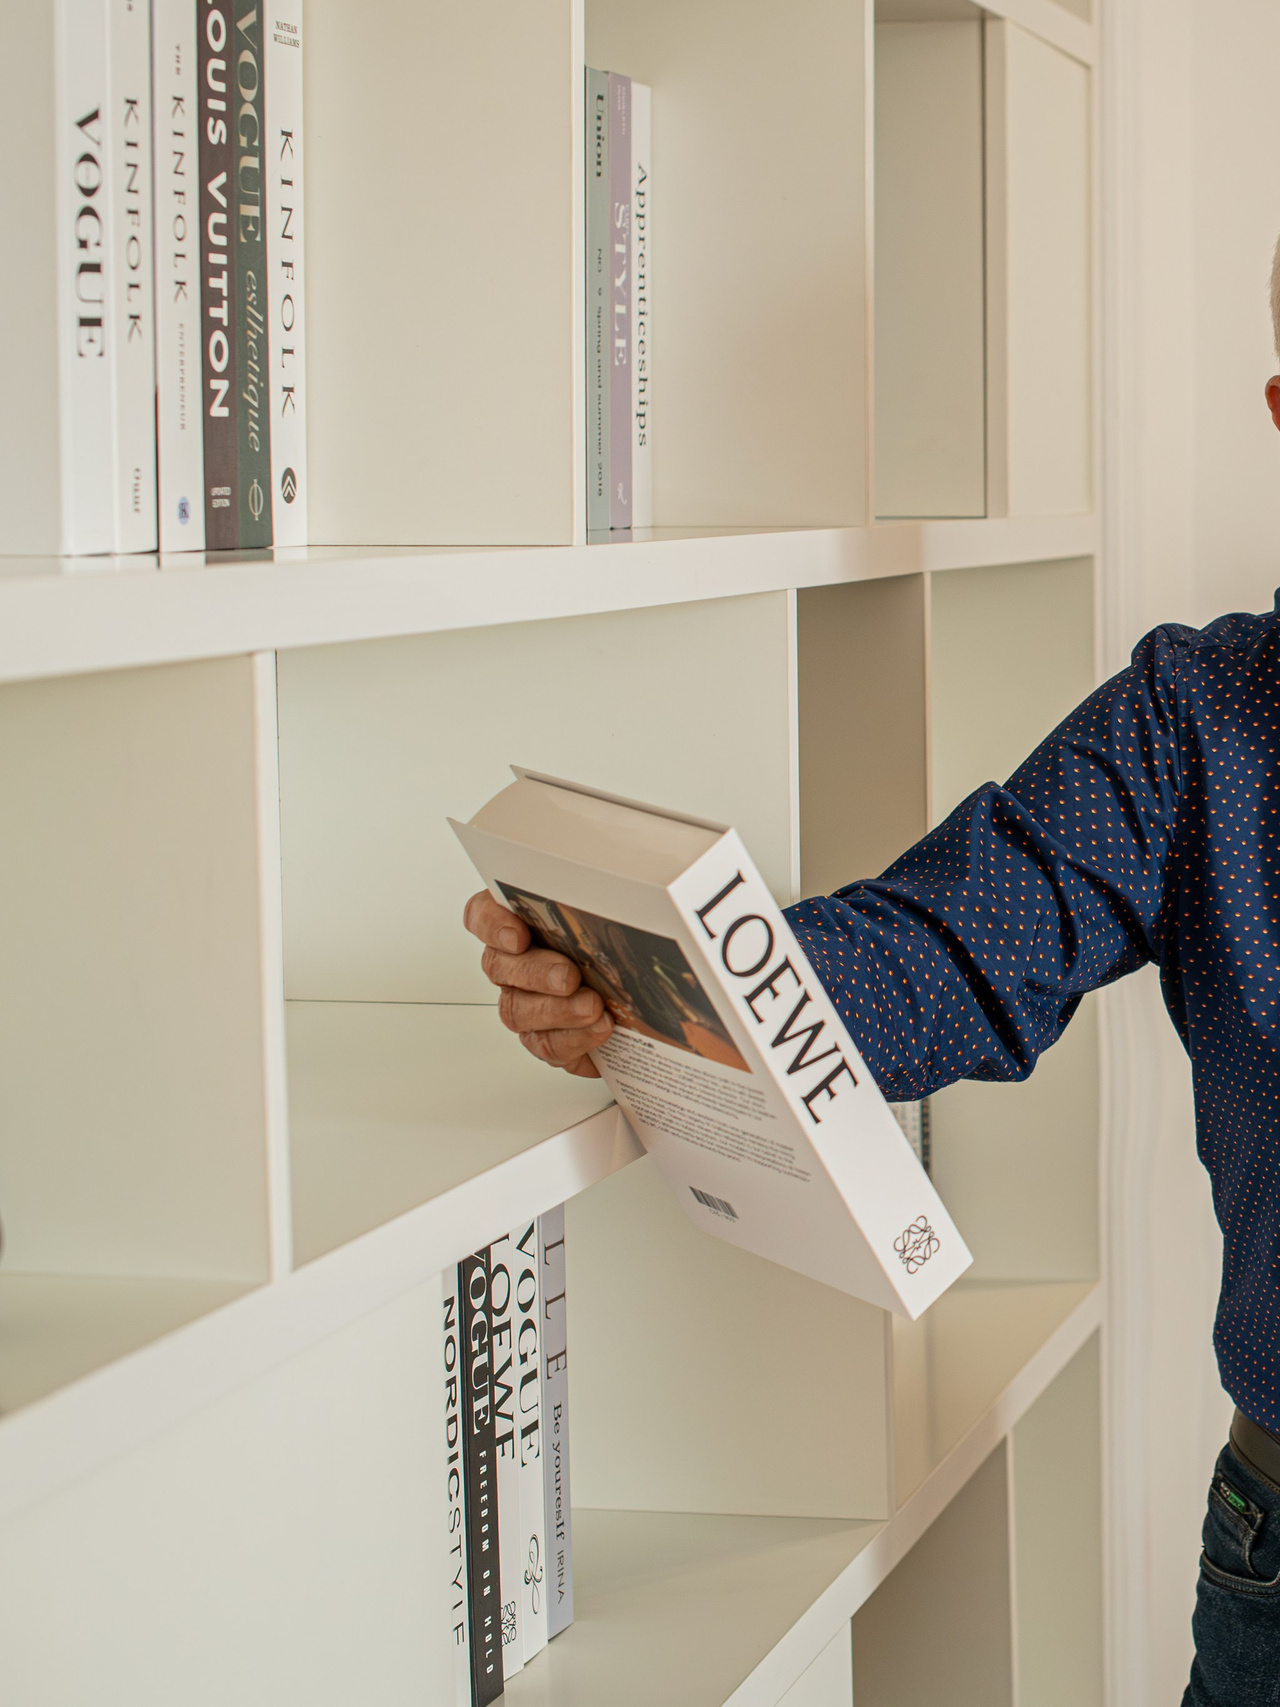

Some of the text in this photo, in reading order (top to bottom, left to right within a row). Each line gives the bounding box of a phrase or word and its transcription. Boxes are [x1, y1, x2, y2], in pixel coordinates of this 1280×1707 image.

[74, 102, 105, 358] VOGUE
[124, 97, 143, 344] KINFOLK
[172, 95, 188, 303] KINFOLK
[206, 0, 230, 418] OUIS VUITTON
[236, 4, 262, 244] VOGUE
[596, 94, 605, 178] Union
[279, 128, 296, 419] KINFOLK
[614, 202, 628, 367] STYLE
[635, 162, 649, 448] Apprenticeships
[694, 869, 859, 1125] LOEWE
[516, 1219, 542, 1468] VOGUE
[552, 1400, 563, 1435] Be
[479, 1450, 490, 1552] FREEDOM
[482, 1569, 491, 1597] ON
[556, 1549, 566, 1605] IRINA
[484, 1615, 494, 1675] HOLD
